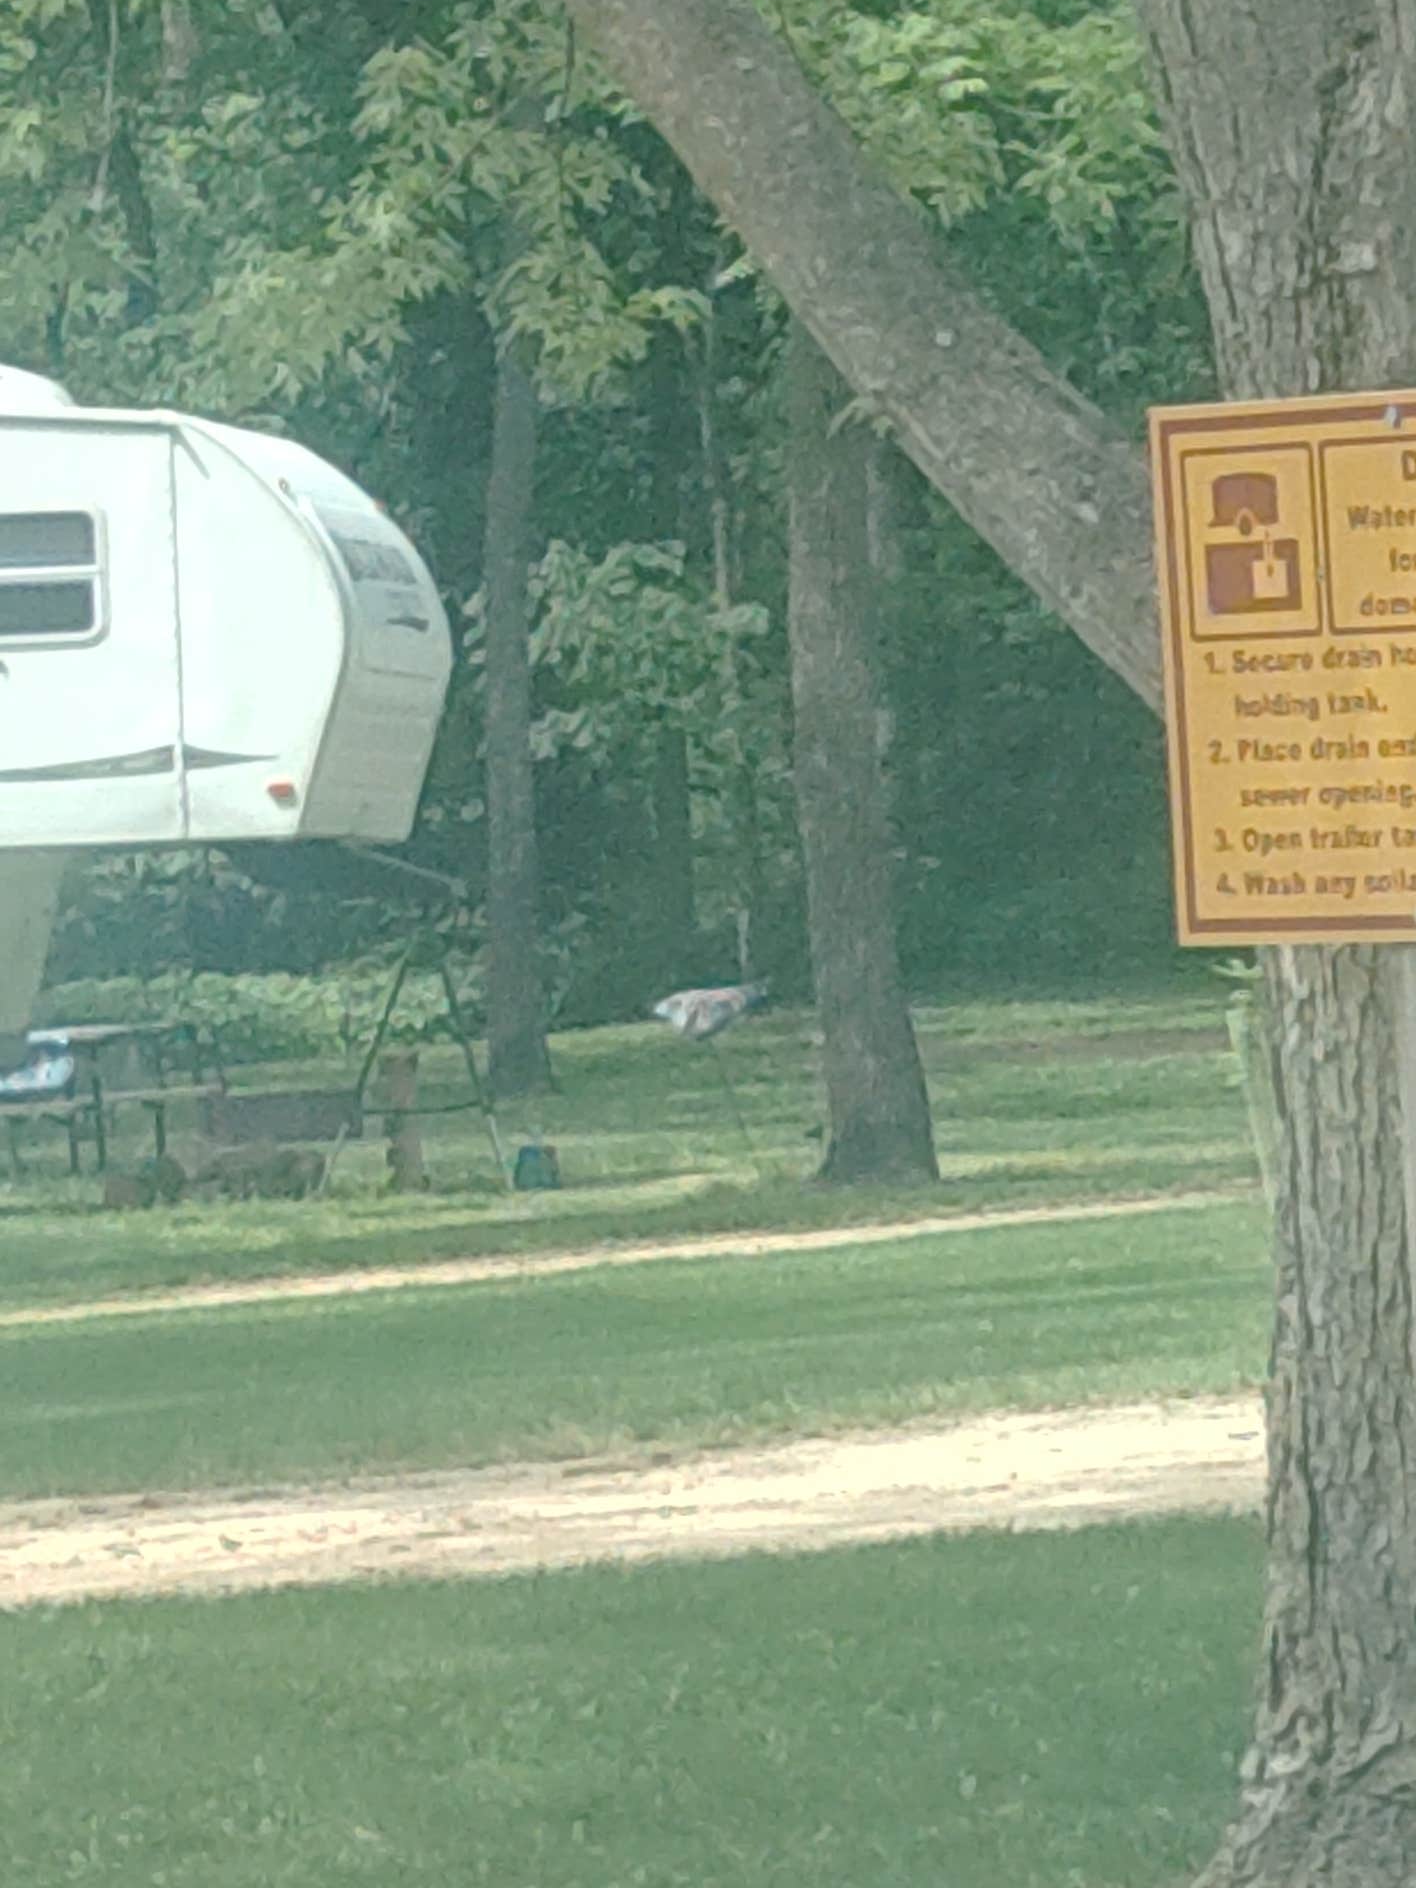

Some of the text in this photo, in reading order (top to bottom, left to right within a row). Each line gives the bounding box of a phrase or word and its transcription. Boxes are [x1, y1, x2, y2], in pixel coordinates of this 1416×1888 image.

[1347, 503, 1416, 529] Water
[1233, 649, 1314, 674] Secure
[1322, 644, 1382, 669] drain
[1235, 687, 1388, 721] holding tank.
[1208, 739, 1230, 765] 2.
[1238, 737, 1301, 762] Place
[1310, 733, 1370, 760] drain
[1241, 787, 1311, 807] sewer
[1243, 827, 1303, 857] Open
[1309, 824, 1383, 849] trailer
[1244, 870, 1306, 896] Wash
[1315, 875, 1356, 900] any
